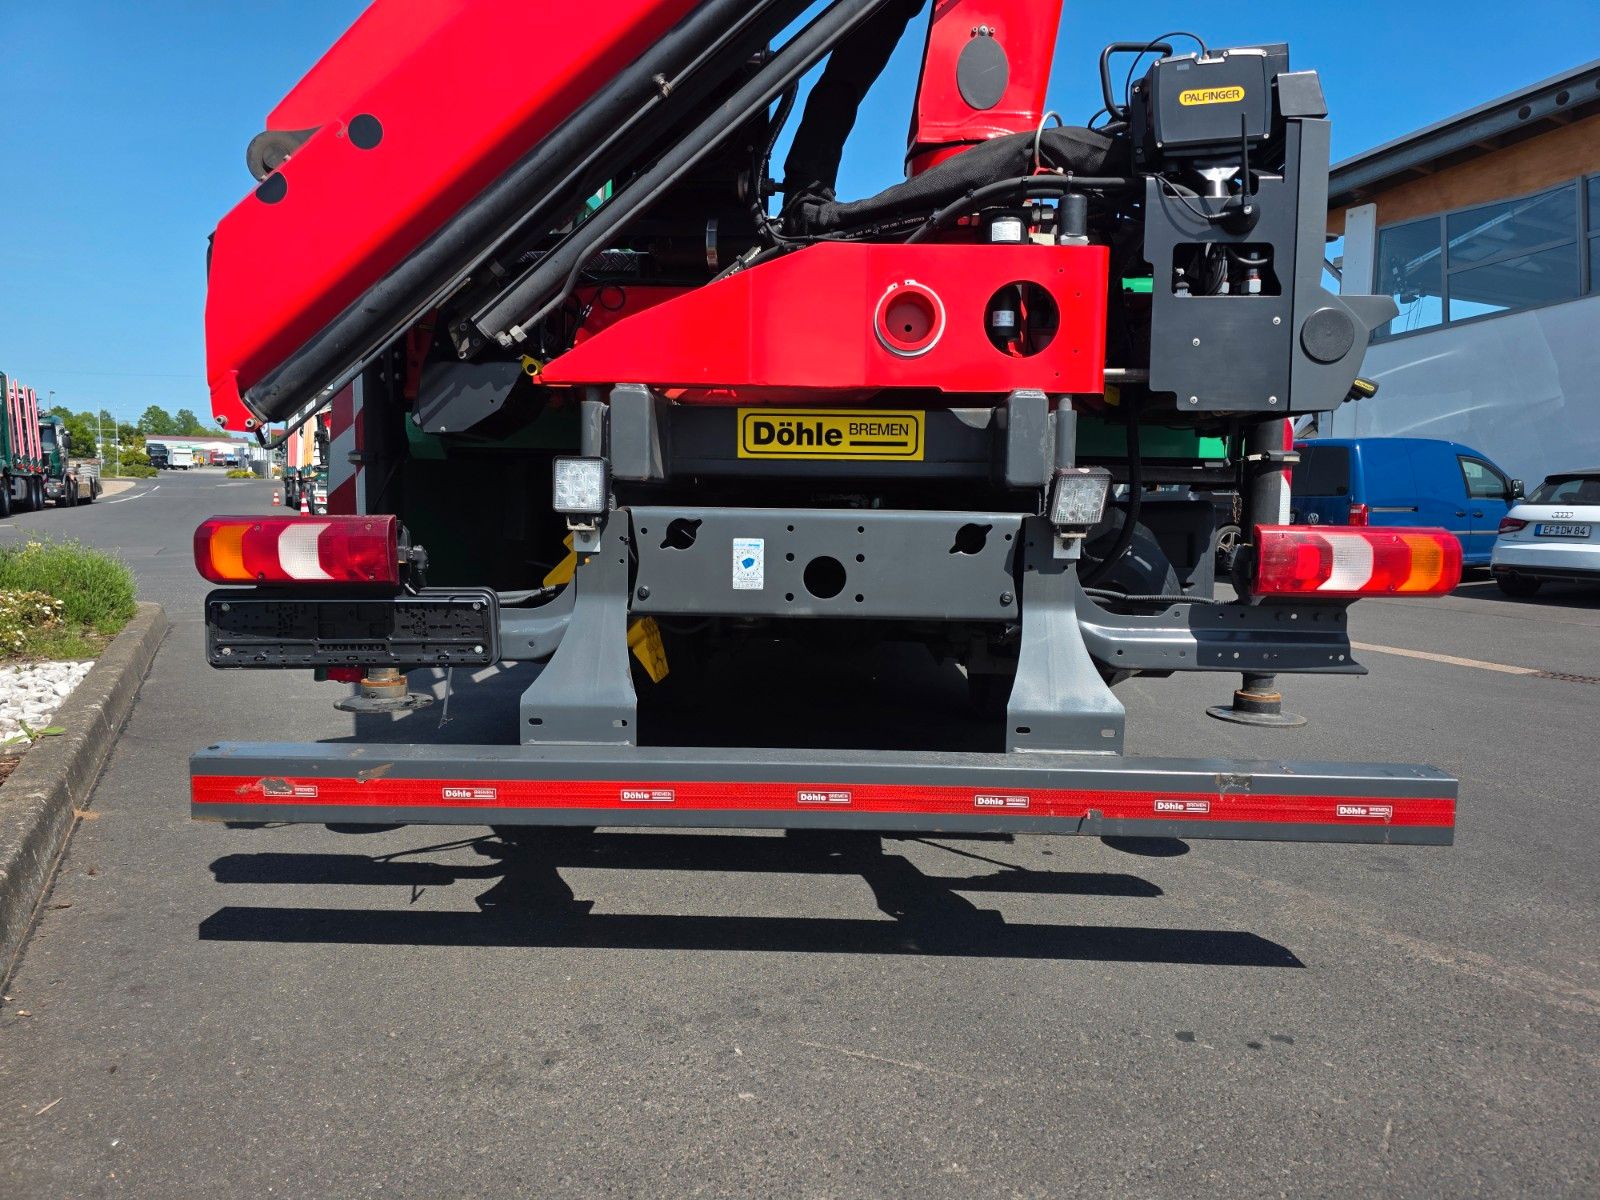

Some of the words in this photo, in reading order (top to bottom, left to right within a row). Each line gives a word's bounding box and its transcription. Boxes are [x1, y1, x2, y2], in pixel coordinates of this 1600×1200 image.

[1184, 90, 1240, 102] PALFINGER
[753, 421, 843, 447] Döhle
[849, 422, 909, 437] BREMEN
[1543, 525, 1556, 535] EF
[1574, 526, 1586, 536] 84
[445, 790, 472, 798] Döhle
[623, 791, 650, 799] Döhle
[800, 793, 827, 801] Döhle
[977, 797, 1004, 805] Döhle
[1157, 802, 1184, 810] Döhle
[1339, 806, 1367, 815] Döhle
